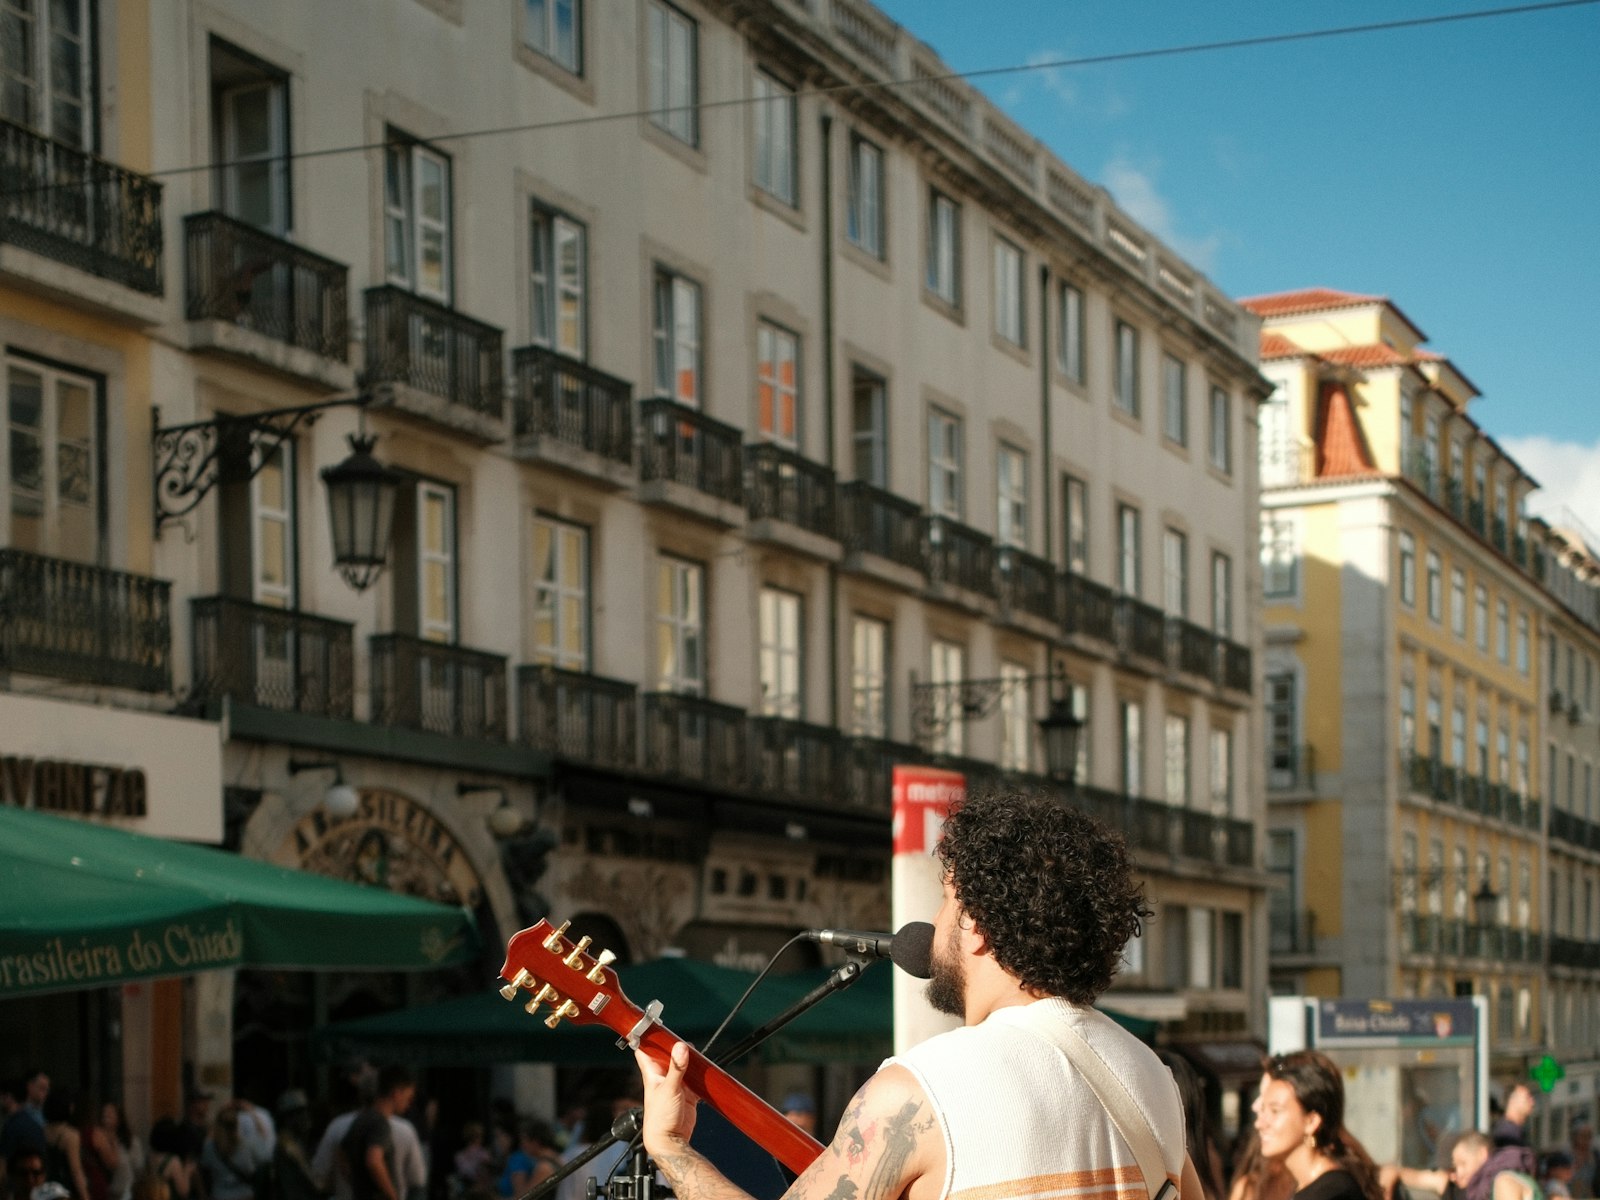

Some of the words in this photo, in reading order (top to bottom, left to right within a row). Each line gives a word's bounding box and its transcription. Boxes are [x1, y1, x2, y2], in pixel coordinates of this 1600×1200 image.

[0, 755, 147, 817] VANEZA
[313, 793, 454, 862] BSILEIRA
[0, 935, 122, 987] rasileira
[127, 930, 163, 973] do
[163, 918, 243, 967] Chiad
